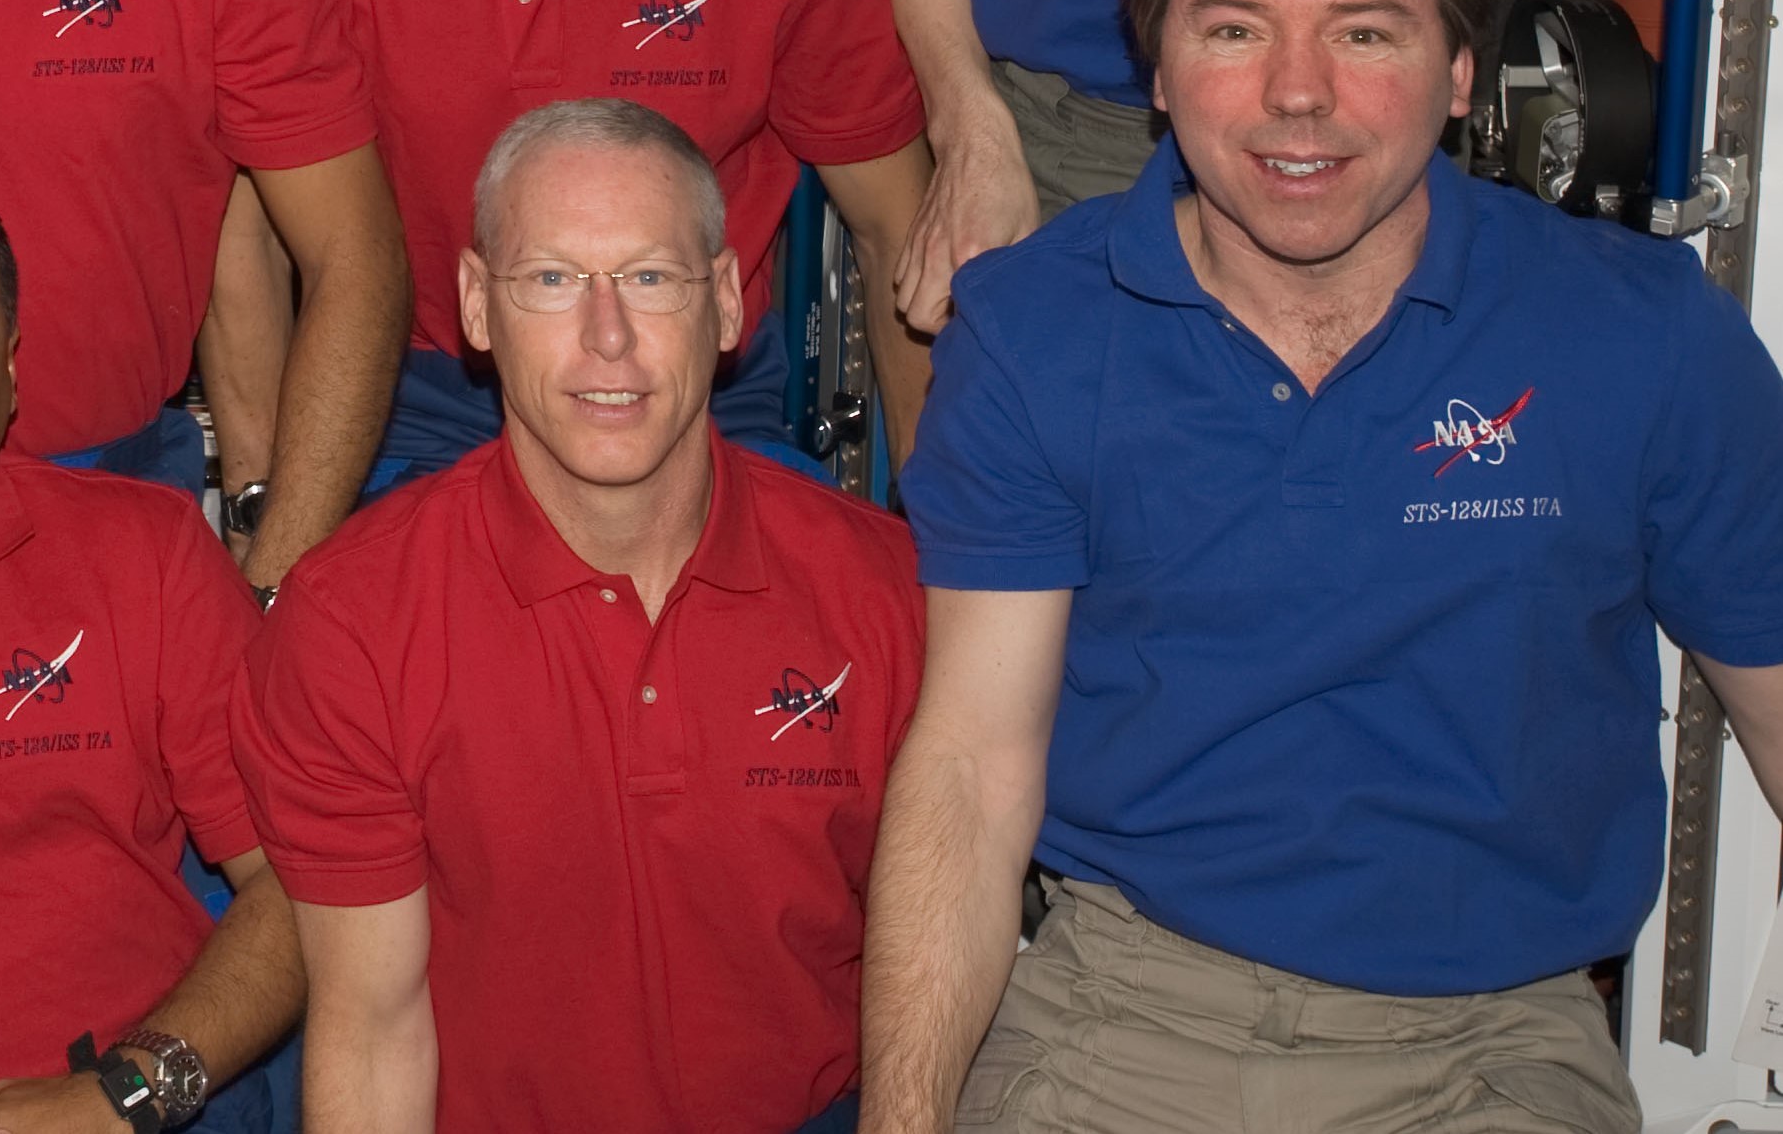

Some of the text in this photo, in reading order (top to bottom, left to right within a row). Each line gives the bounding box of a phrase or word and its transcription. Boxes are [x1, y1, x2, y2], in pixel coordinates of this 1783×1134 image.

[639, 3, 704, 26] NASA
[129, 56, 155, 74] 17A
[1433, 419, 1517, 447] NASA
[1403, 497, 1562, 523] STS-128/ISS 17A
[2, 661, 73, 690] NASA
[770, 687, 840, 715] NASA
[86, 730, 112, 750] 17A
